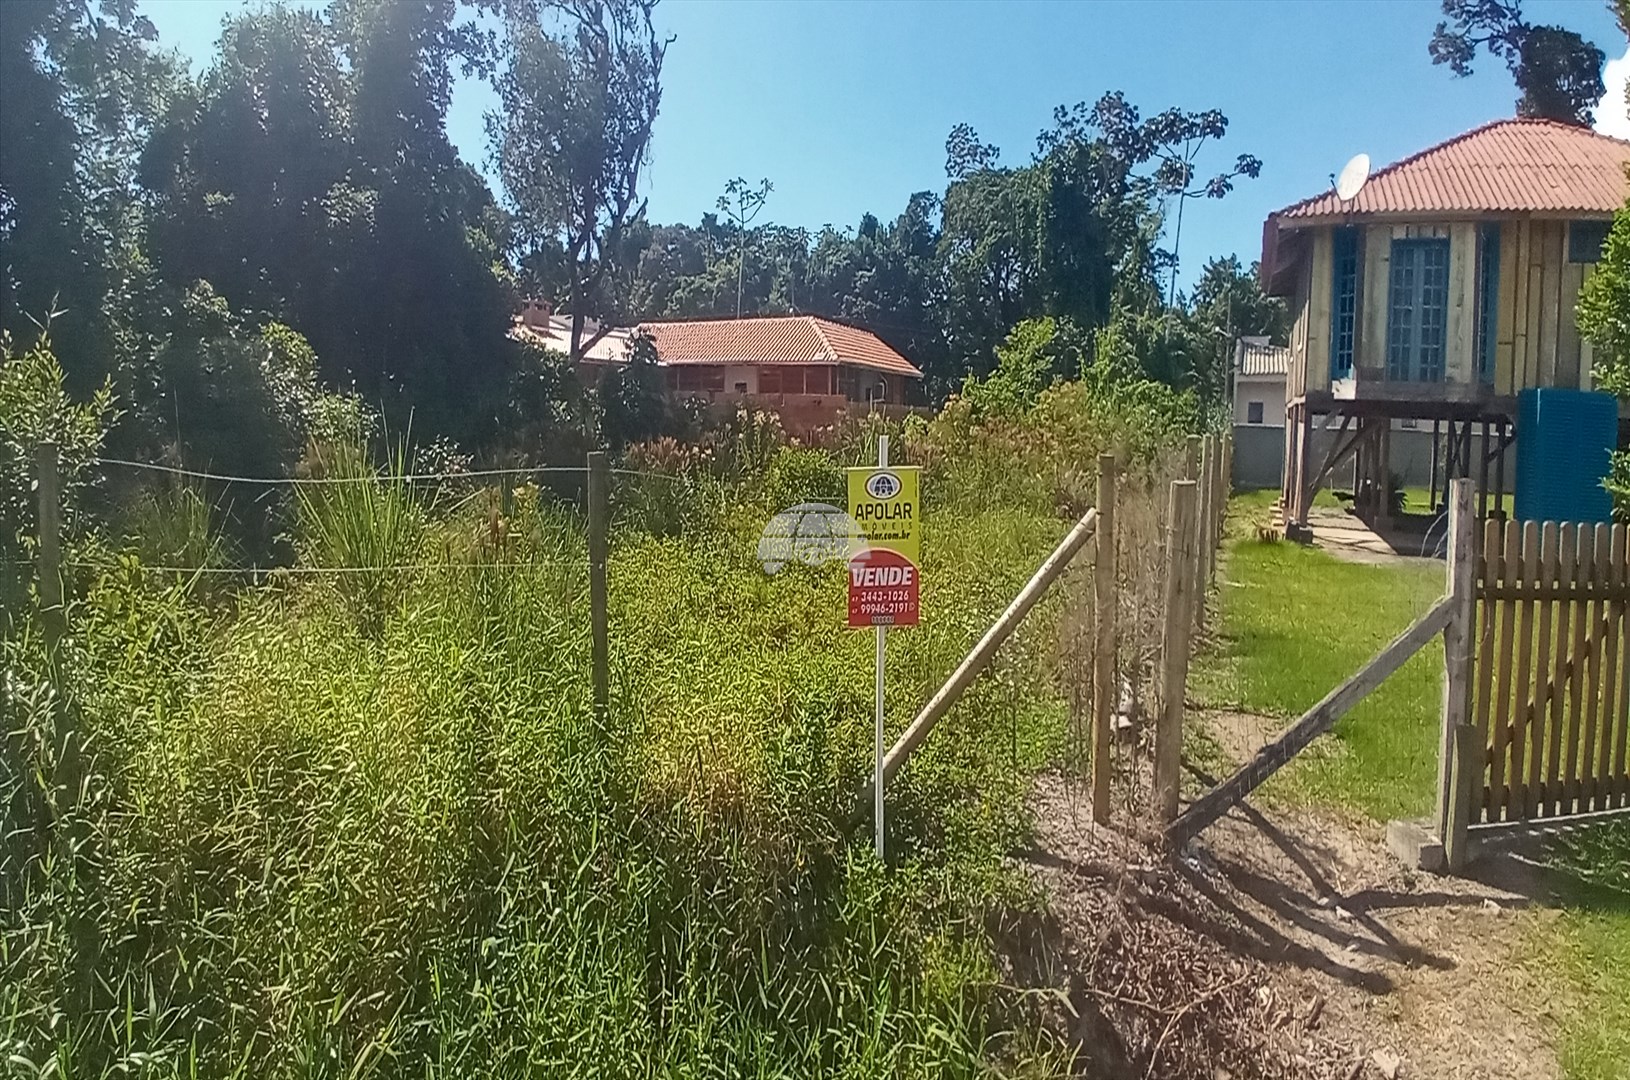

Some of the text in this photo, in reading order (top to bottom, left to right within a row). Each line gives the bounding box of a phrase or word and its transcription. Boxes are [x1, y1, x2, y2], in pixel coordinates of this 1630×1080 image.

[855, 502, 912, 520] APOLAR
[852, 566, 914, 587] VENDE
[861, 590, 909, 602] 3443-1026
[860, 602, 908, 615] 99946-2191
